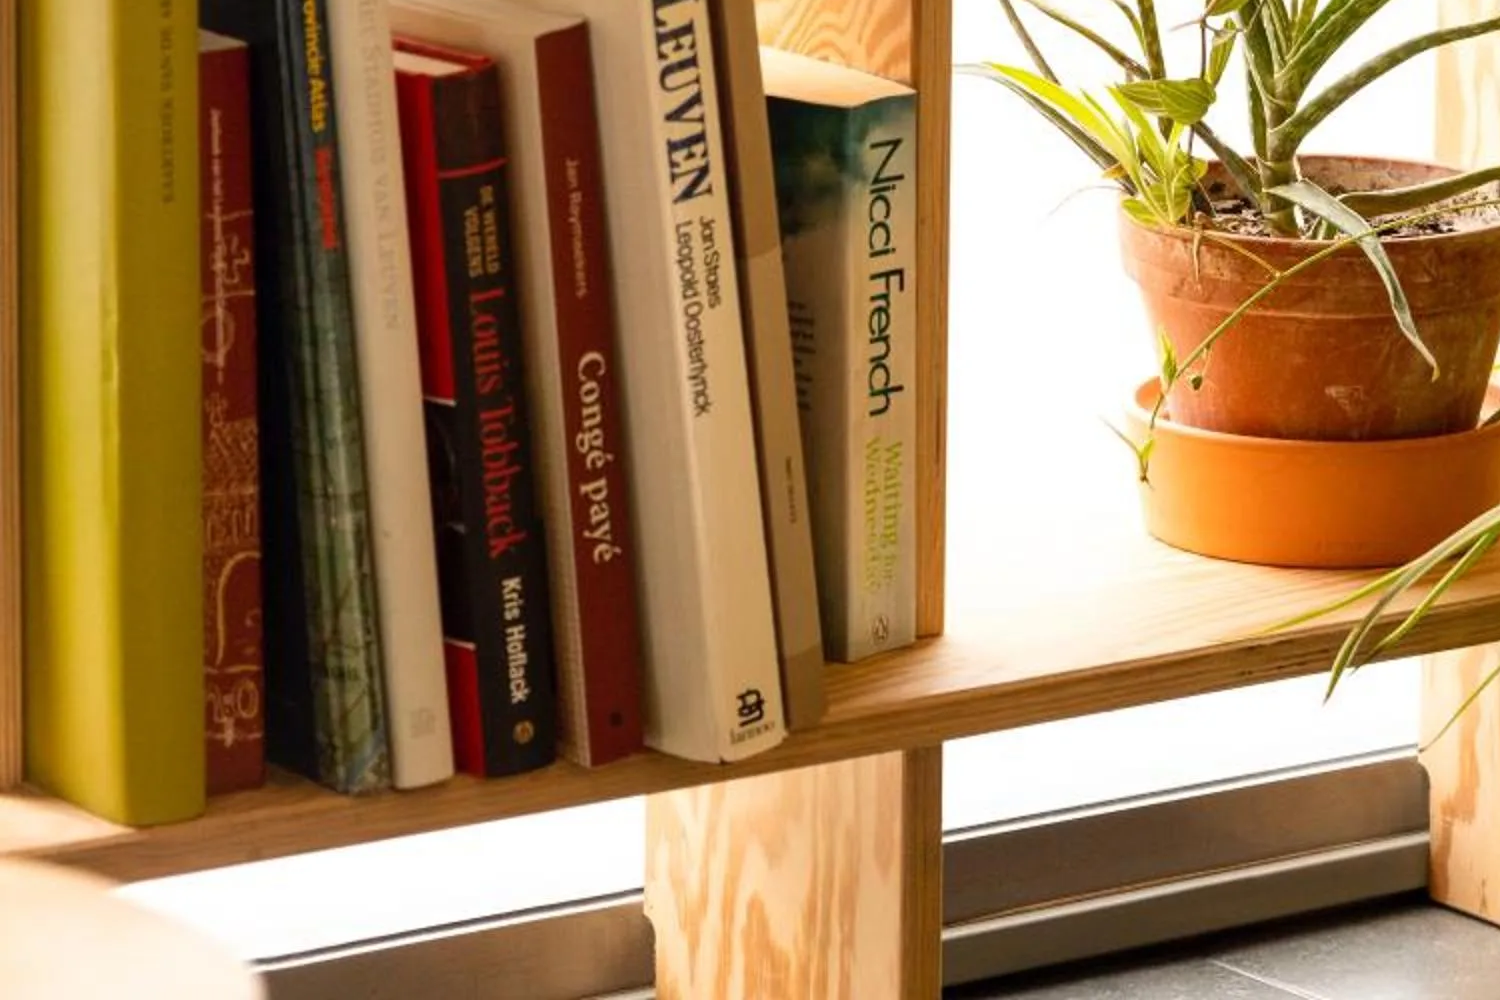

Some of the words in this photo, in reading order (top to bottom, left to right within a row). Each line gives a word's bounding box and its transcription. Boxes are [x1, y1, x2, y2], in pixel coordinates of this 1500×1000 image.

[310, 78, 327, 133] Atlas
[701, 216, 716, 250] Jan
[869, 138, 904, 258] Nicci
[676, 220, 699, 300] Leopold
[704, 250, 722, 309] Staes
[471, 289, 504, 394] Louis
[684, 300, 712, 417] Oosterlynck
[869, 268, 904, 417] French
[576, 352, 614, 469] Congé
[479, 401, 527, 559] Tobback
[580, 477, 622, 564] payé
[882, 441, 903, 545] Waiting
[501, 577, 524, 621] Kris
[505, 624, 531, 704] Hoflack
